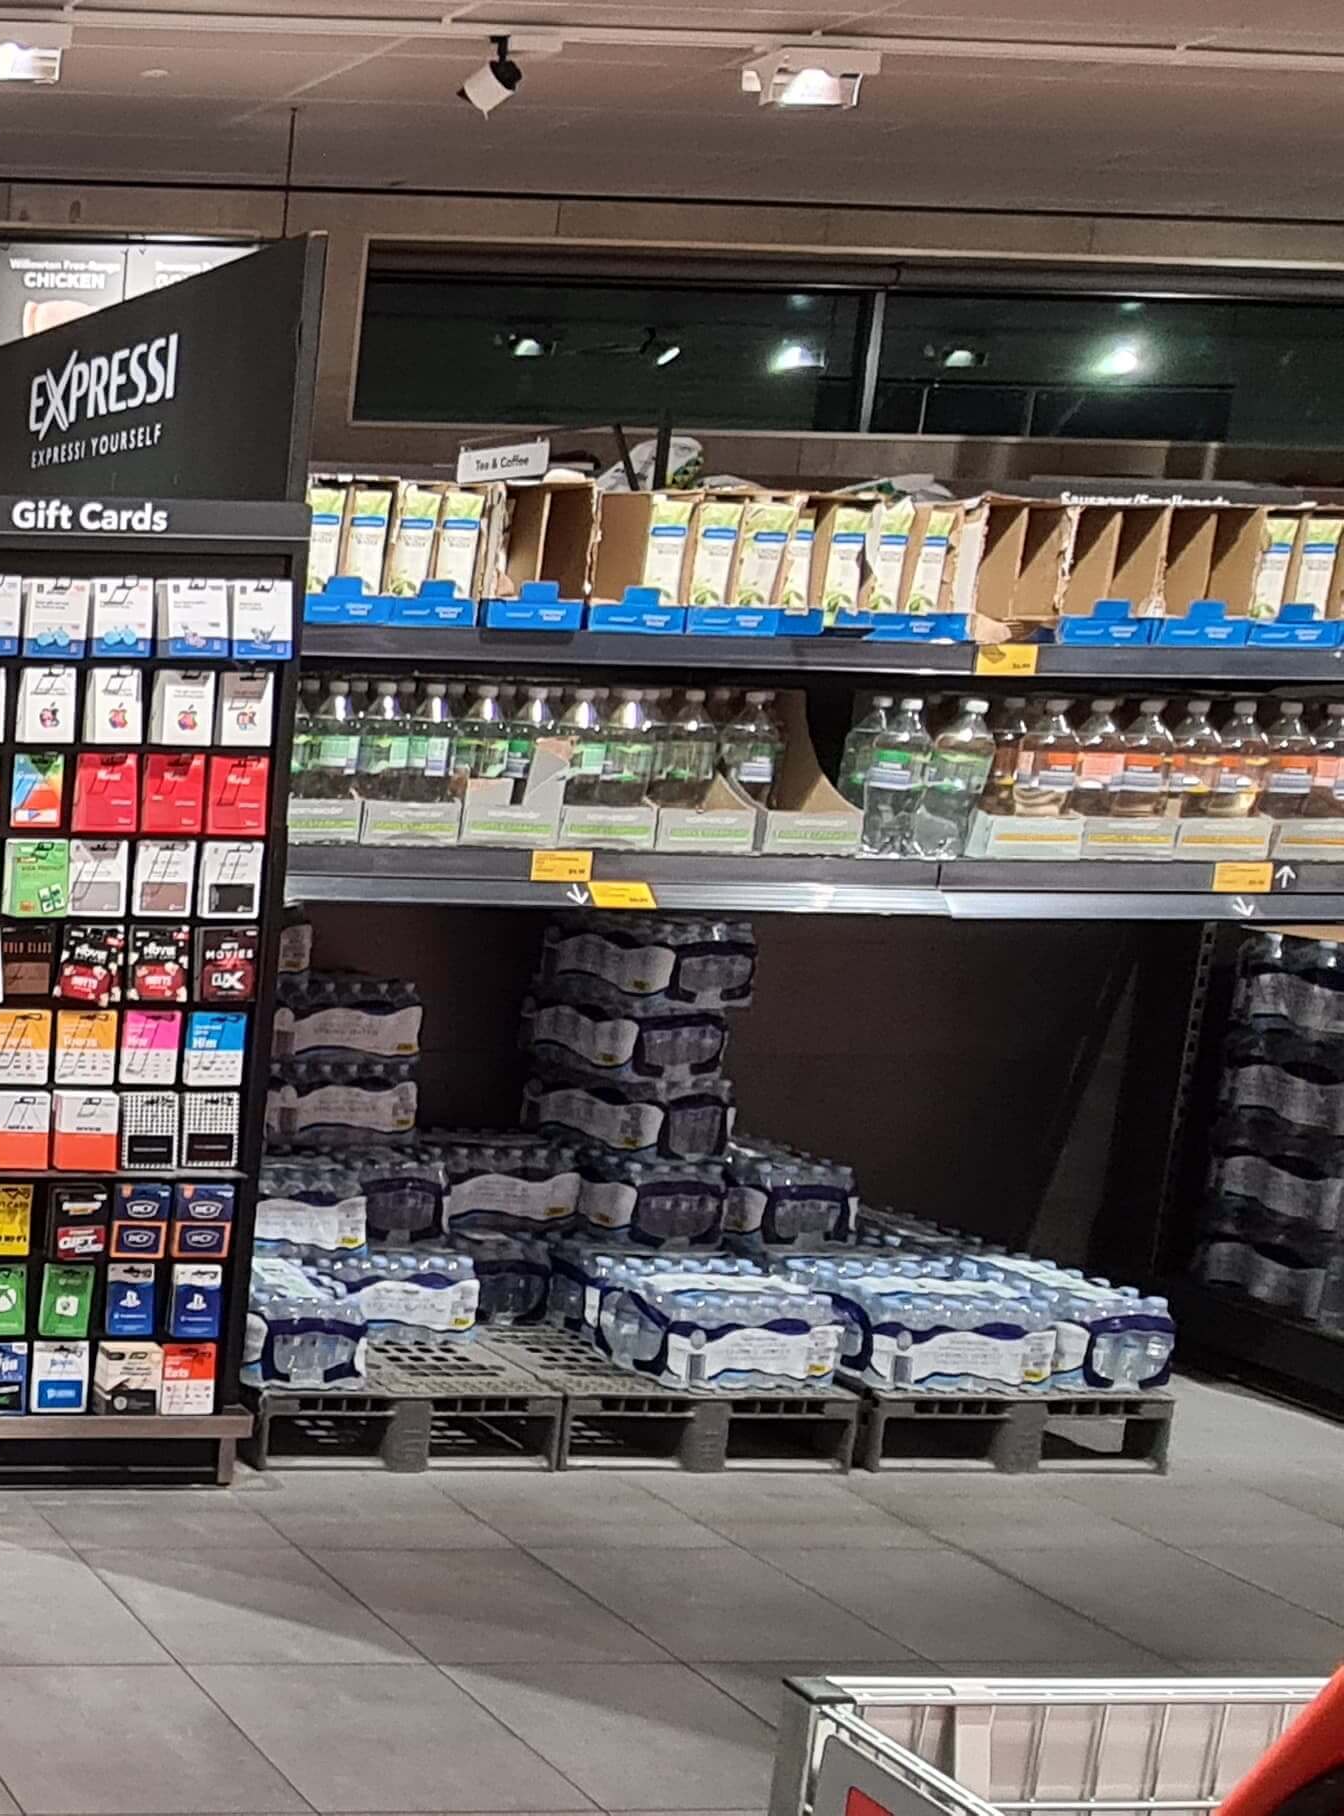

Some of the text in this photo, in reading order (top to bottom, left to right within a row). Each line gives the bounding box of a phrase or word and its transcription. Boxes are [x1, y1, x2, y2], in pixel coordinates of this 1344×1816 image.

[23, 272, 105, 289] CHICKEN
[28, 333, 180, 441] EXPRESSI
[30, 423, 163, 470] EXPRESSI YOURSELF
[475, 459, 489, 472] Tea
[500, 454, 530, 468] Coffee
[12, 500, 169, 533] Gift Cards
